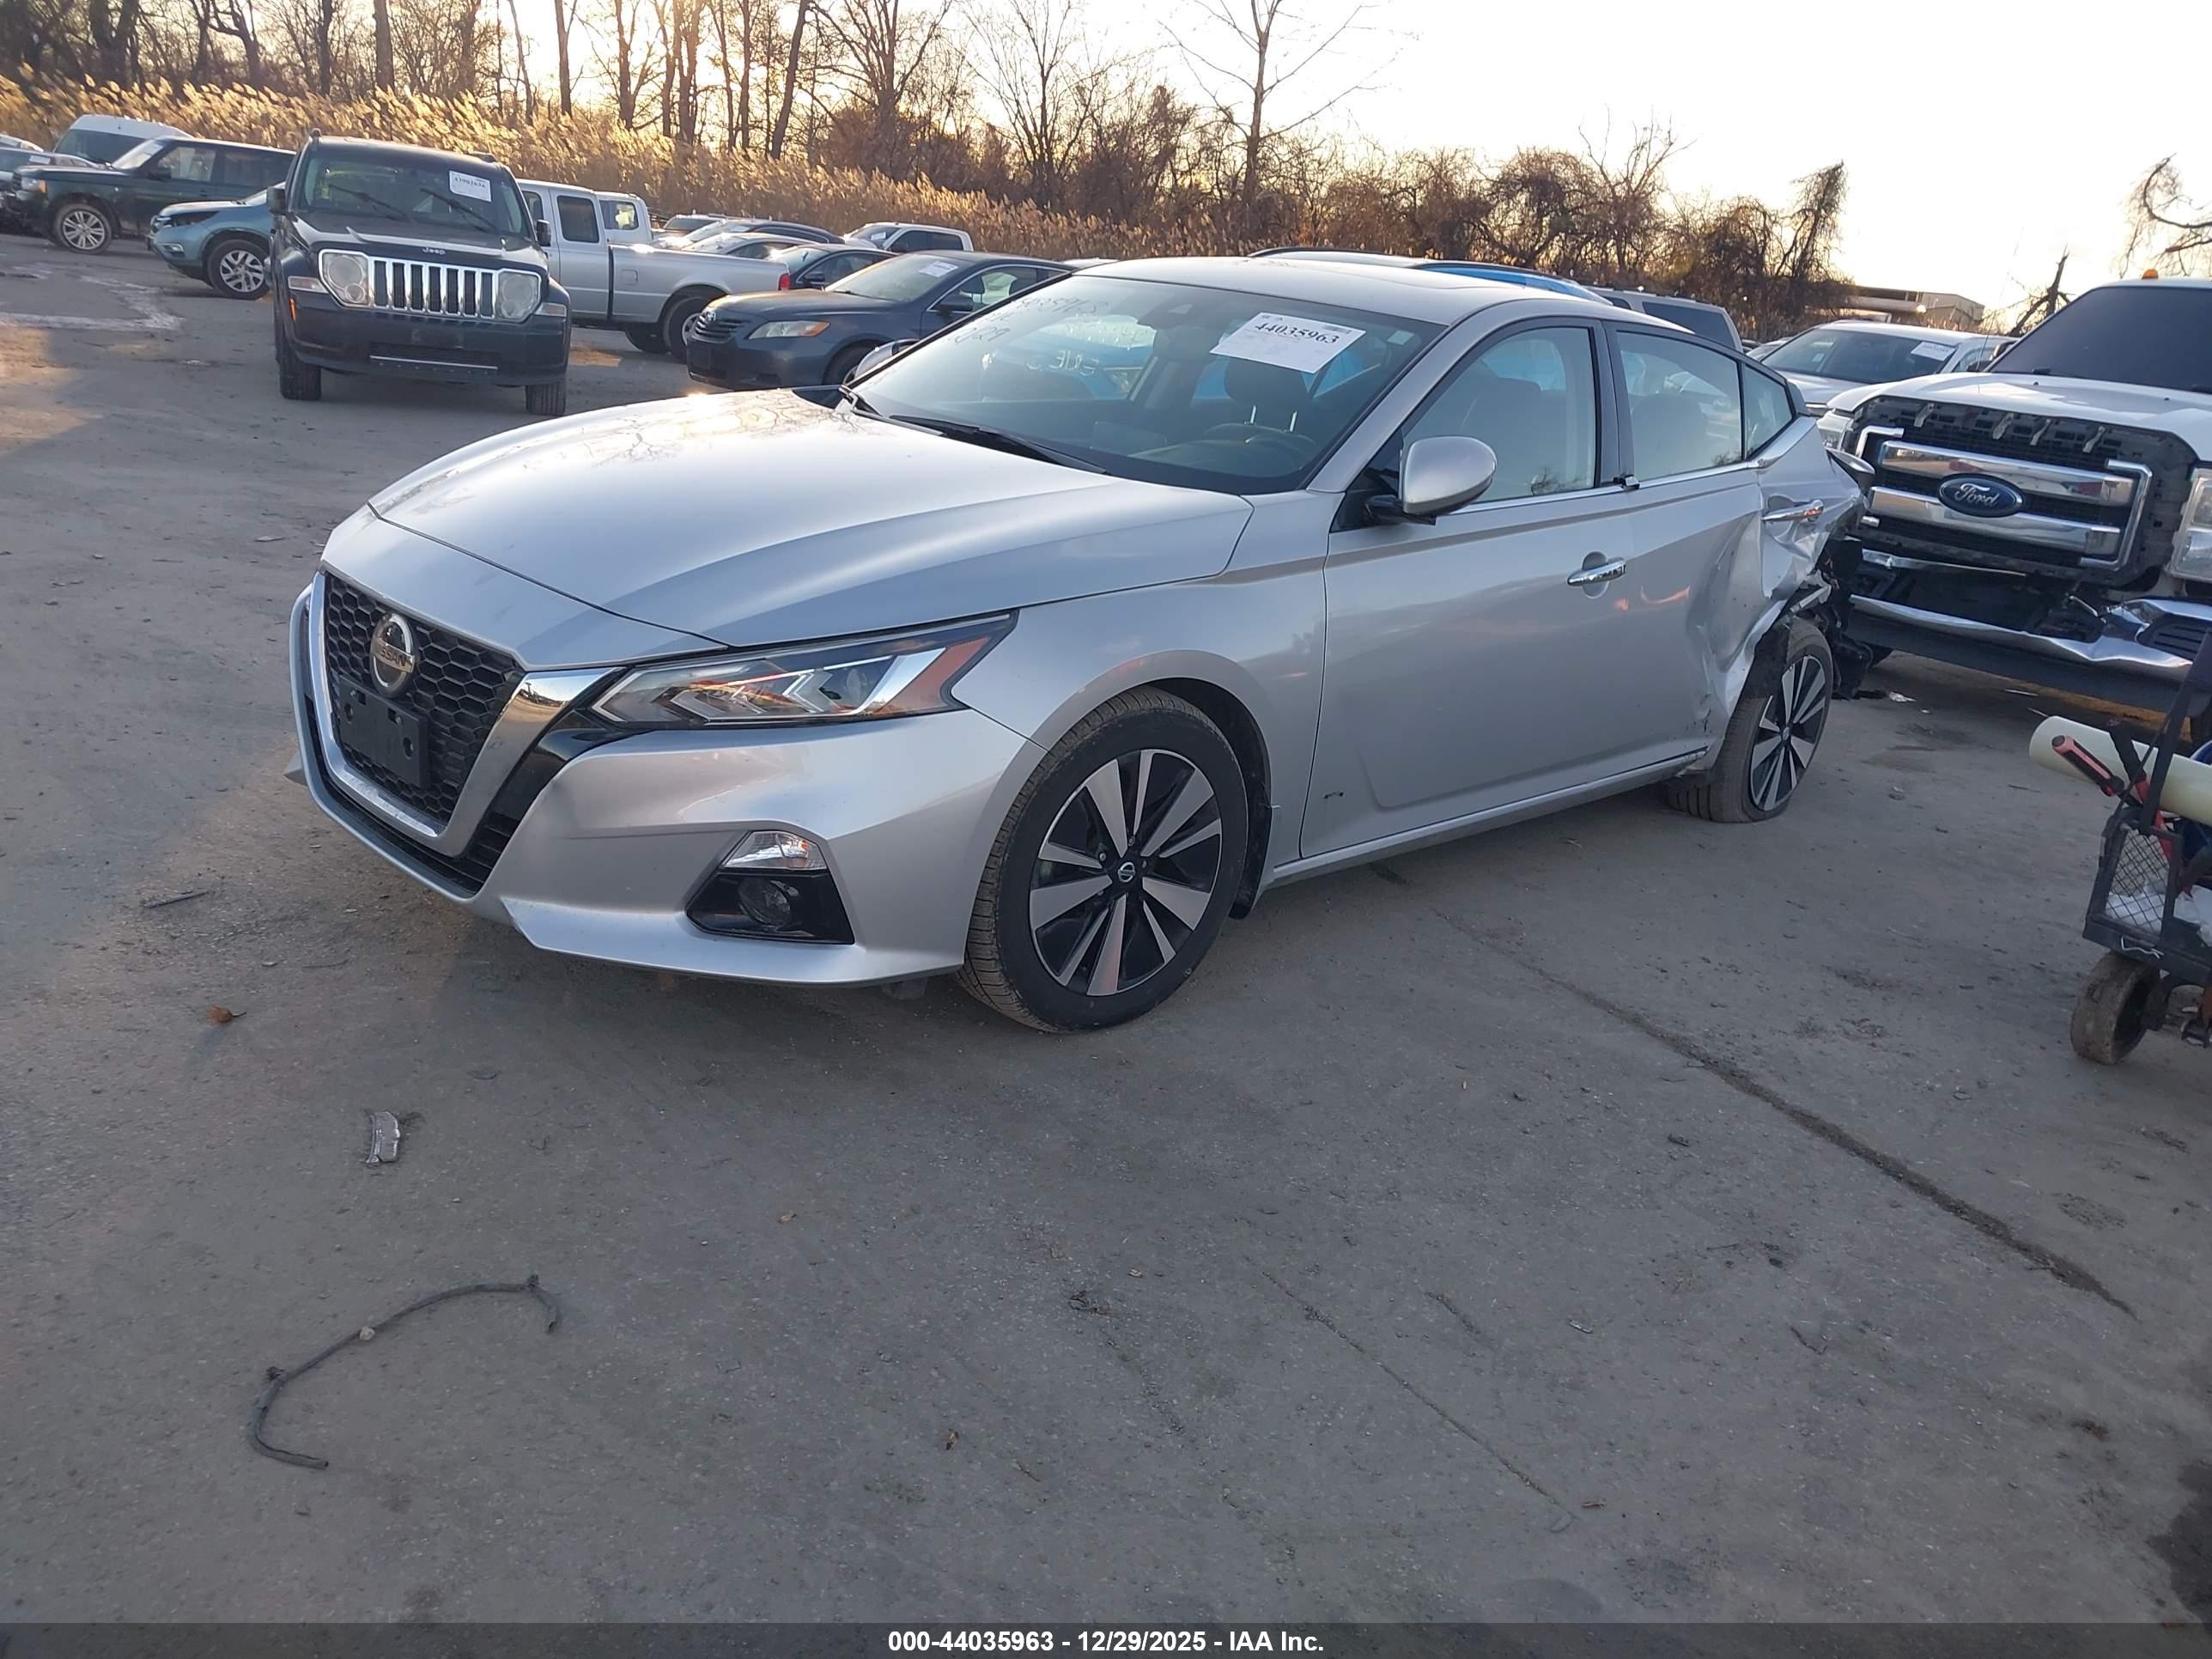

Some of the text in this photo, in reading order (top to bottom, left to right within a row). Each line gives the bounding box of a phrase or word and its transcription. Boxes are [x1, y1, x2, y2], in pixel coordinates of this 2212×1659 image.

[422, 246, 446, 255] Jeep
[1255, 322, 1340, 344] 44035963
[1954, 483, 2000, 507] Ford
[376, 644, 407, 667] SSAN
